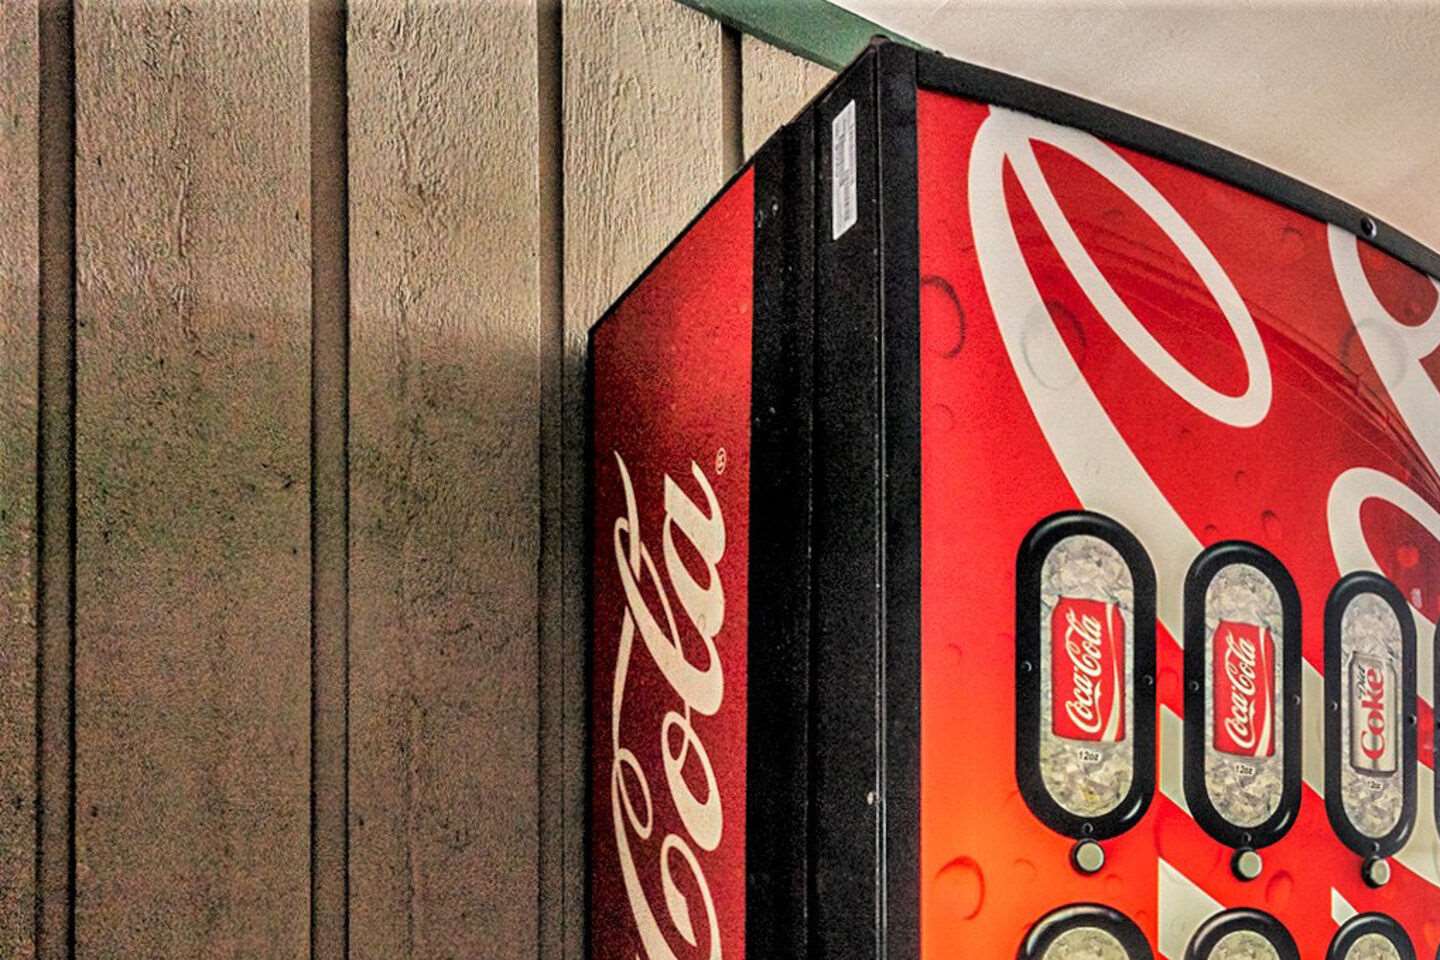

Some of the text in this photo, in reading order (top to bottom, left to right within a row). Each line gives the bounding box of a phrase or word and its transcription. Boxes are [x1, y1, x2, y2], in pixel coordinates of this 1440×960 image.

[1065, 606, 1102, 734] Coca-Cola
[1224, 628, 1256, 749] Coca-Cola
[1361, 667, 1385, 761] Coke
[1078, 749, 1100, 762] 12oz
[1234, 764, 1254, 776] 12oz
